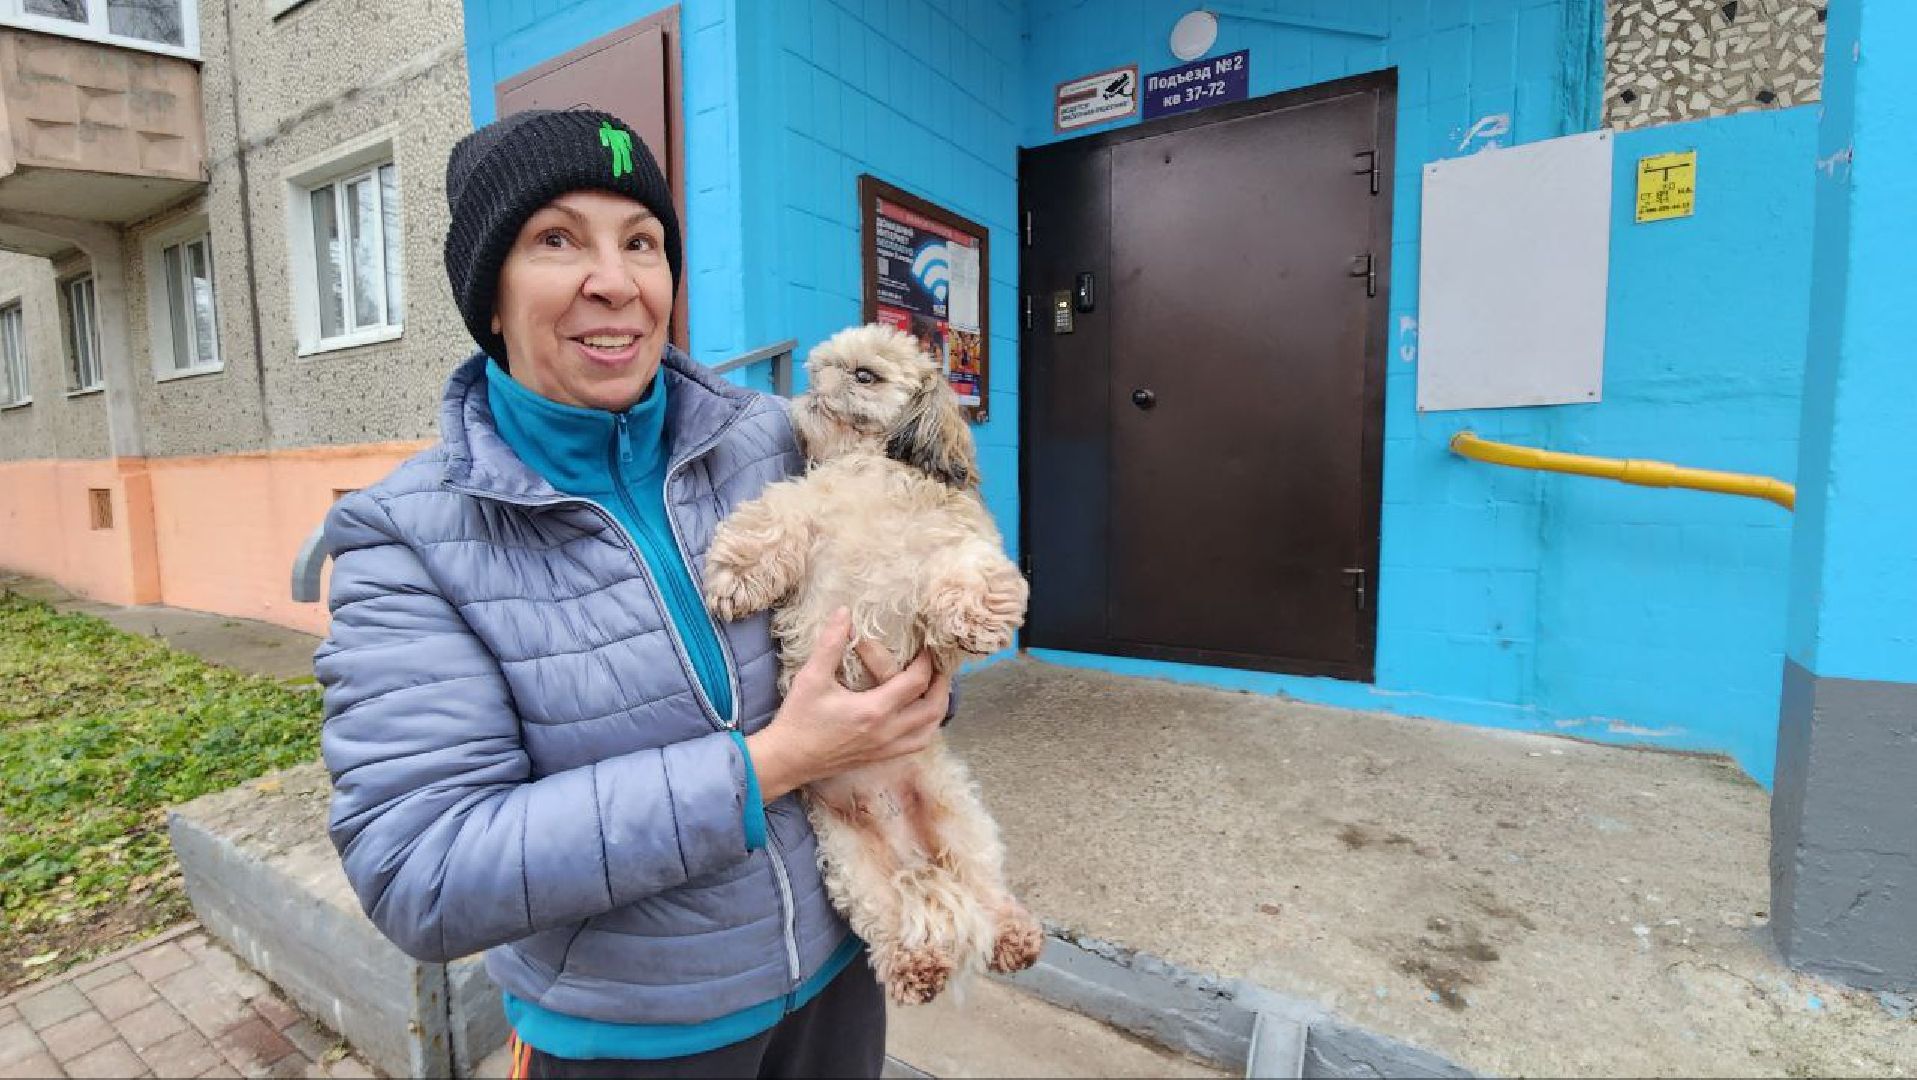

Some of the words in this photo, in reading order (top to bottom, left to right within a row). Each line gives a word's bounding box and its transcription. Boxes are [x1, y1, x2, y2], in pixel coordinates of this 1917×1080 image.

[1148, 65, 1211, 91] Подъезд
[1163, 93, 1181, 108] кв
[1185, 81, 1226, 102] 37-72
